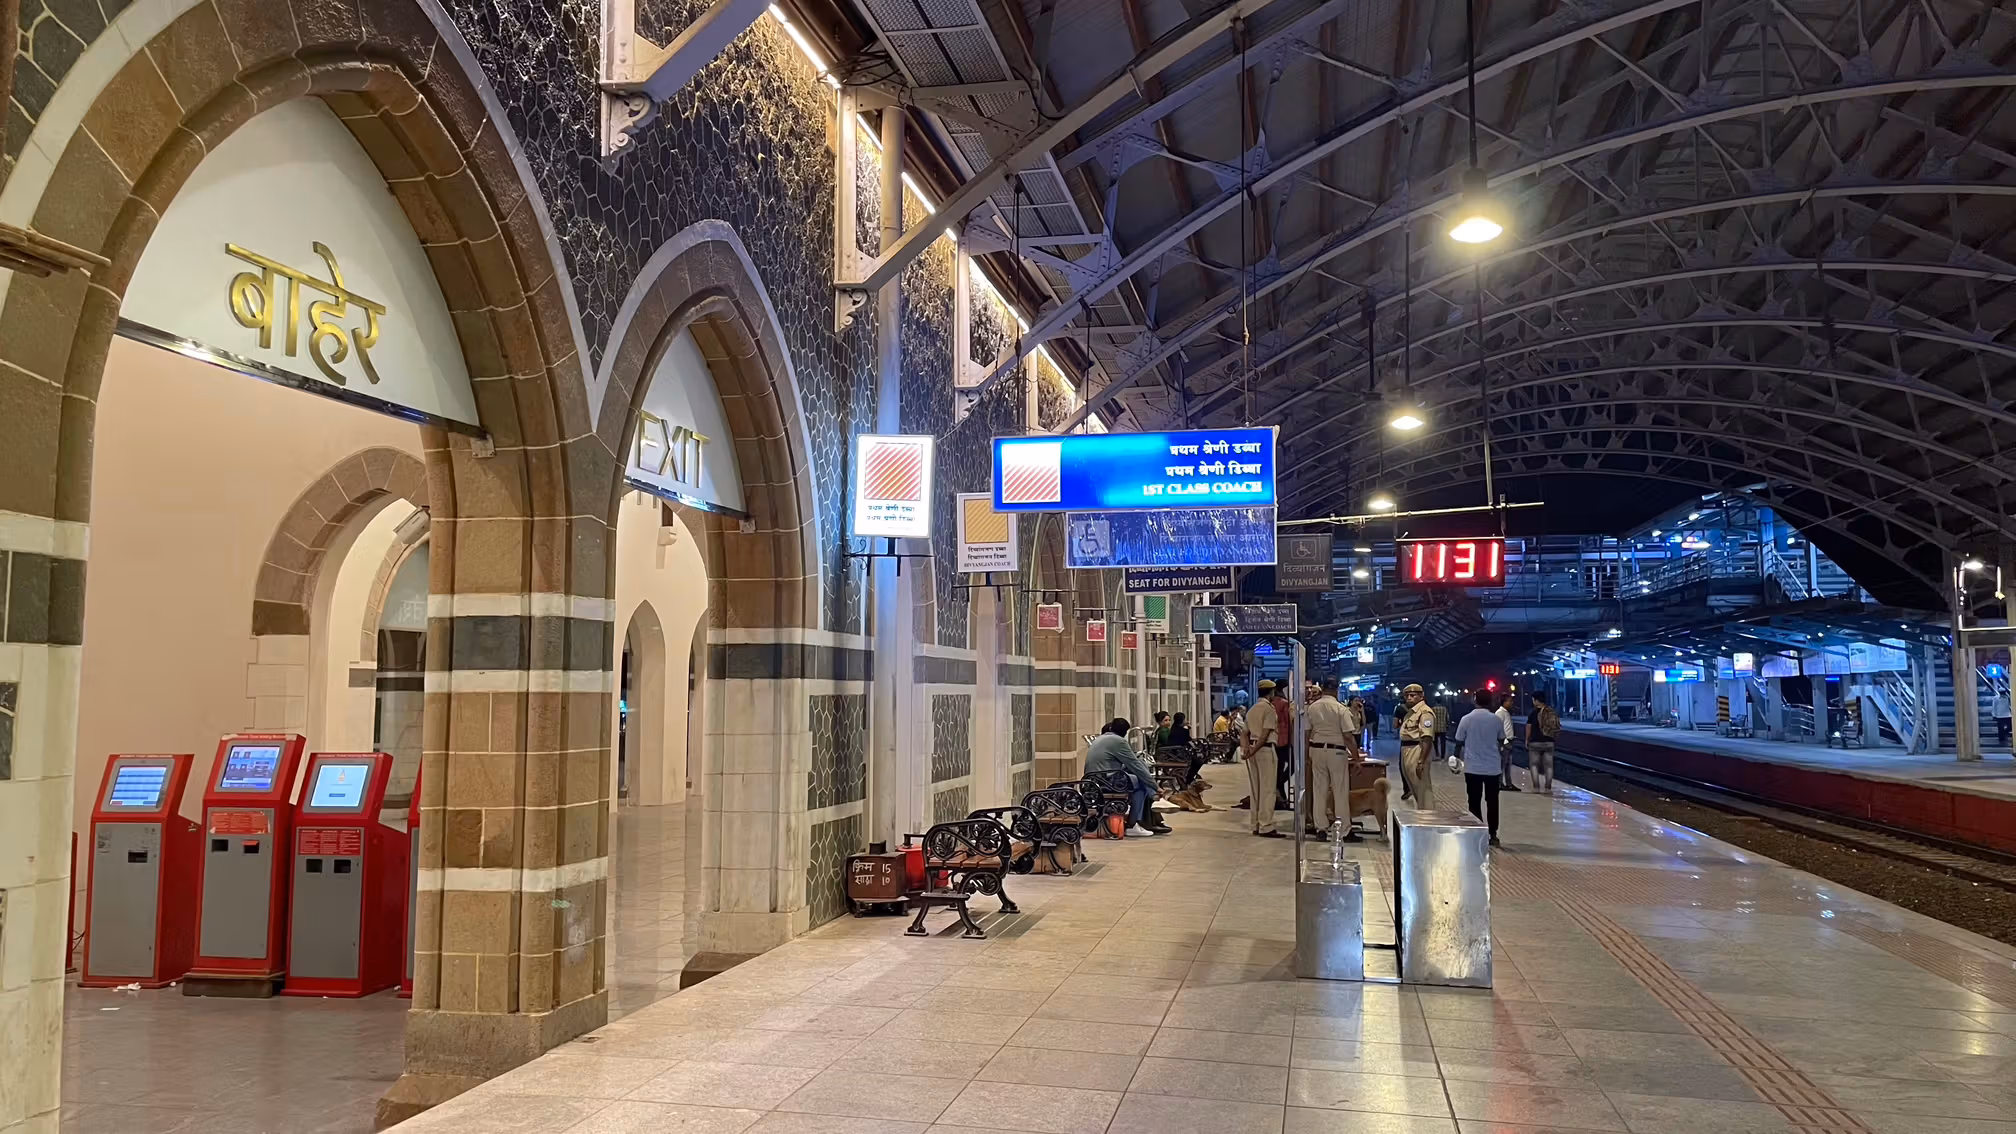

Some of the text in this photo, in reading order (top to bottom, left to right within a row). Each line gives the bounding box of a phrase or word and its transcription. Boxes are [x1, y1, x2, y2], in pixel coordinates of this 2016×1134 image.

[225, 241, 386, 386] बाहेर
[636, 409, 711, 489] EXIT
[1169, 440, 1261, 456] प्रथम श्रेणी डब्बा
[1165, 460, 1262, 477] प्रथम श्रेणी डिब्बा
[1143, 481, 1263, 496] 1ST CLASS COACH
[1128, 575, 1228, 588] SEAT FOR DIVYANGJAN
[1281, 577, 1328, 586] DIVYANGJAN
[881, 863, 892, 874] 15
